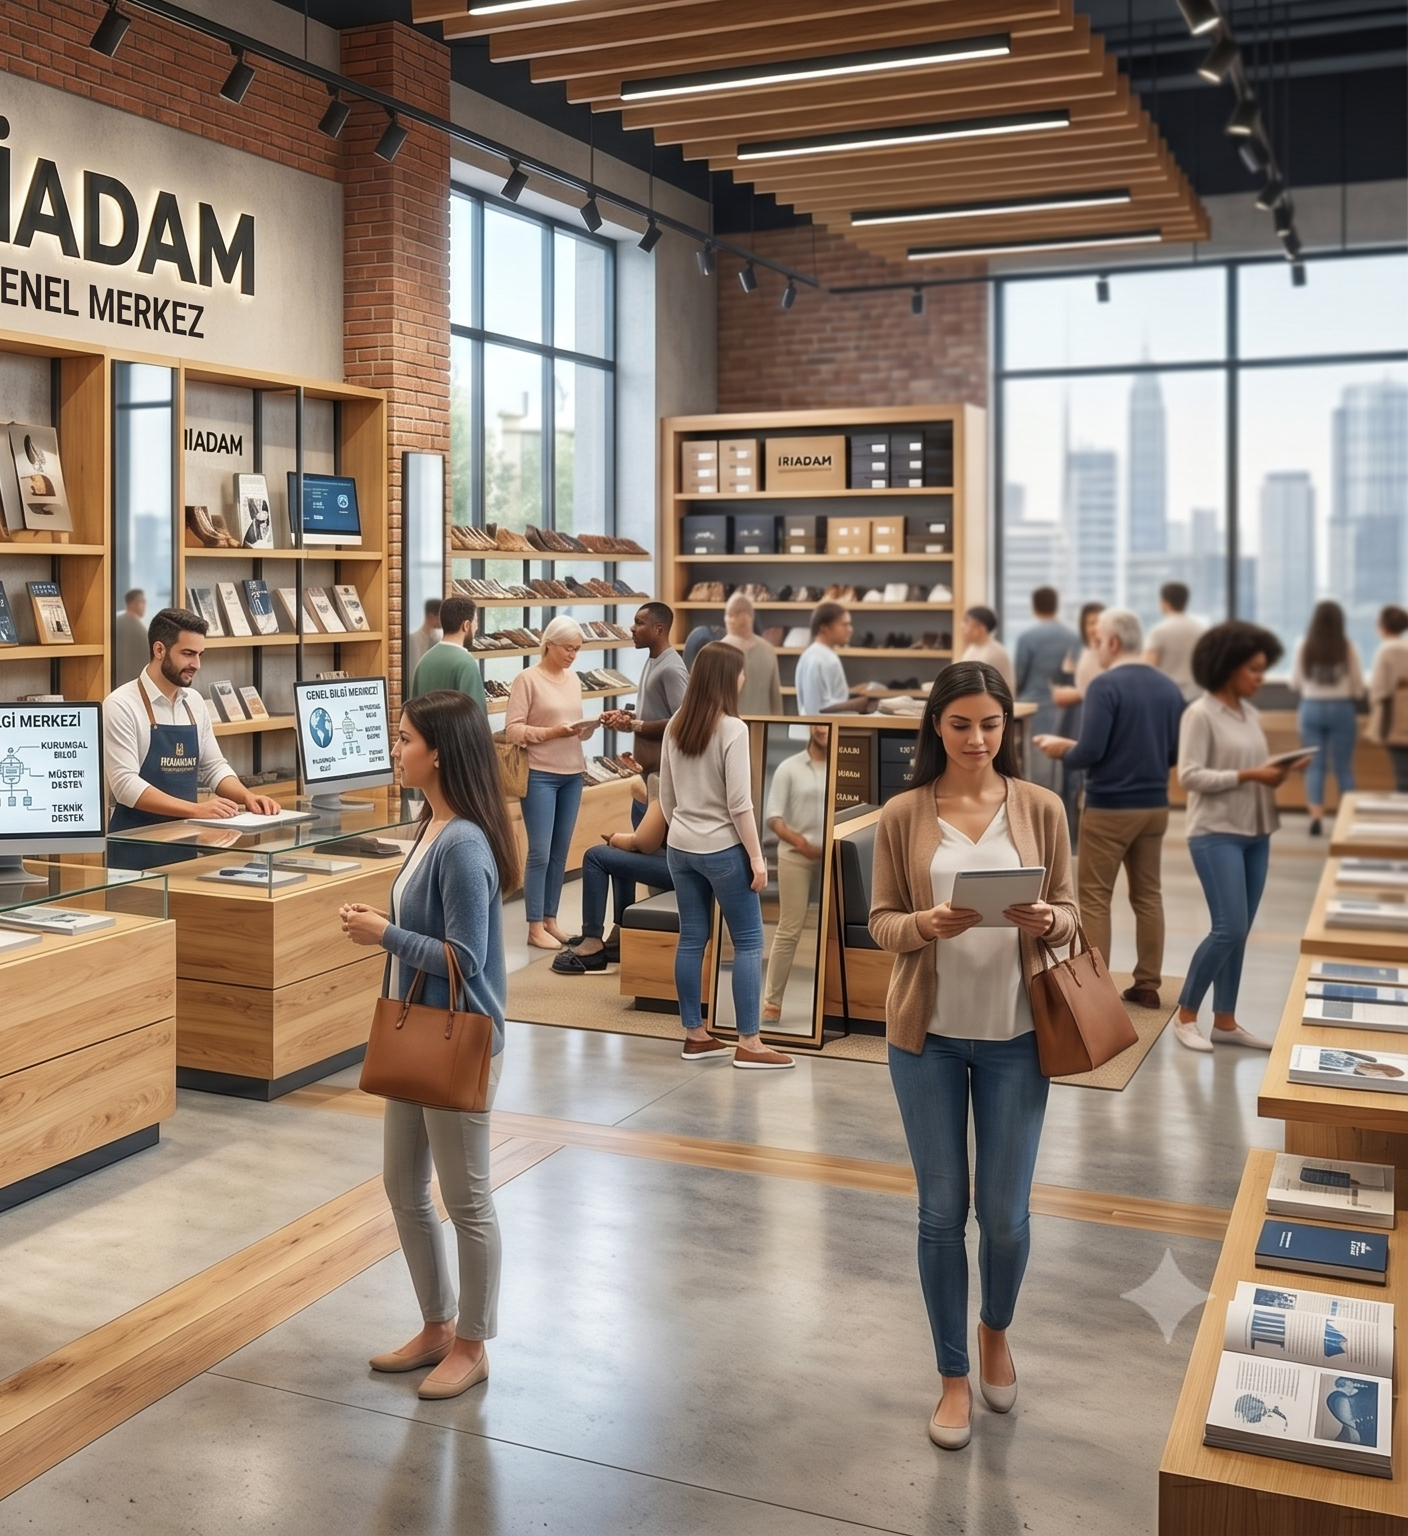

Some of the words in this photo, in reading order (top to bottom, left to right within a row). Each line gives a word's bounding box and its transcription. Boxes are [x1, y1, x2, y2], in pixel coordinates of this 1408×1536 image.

[90, 284, 205, 339] MERKEZ
[778, 456, 832, 466] IRIADAM
[20, 712, 81, 728] MERKEZİ
[52, 814, 84, 823] DESTEK
